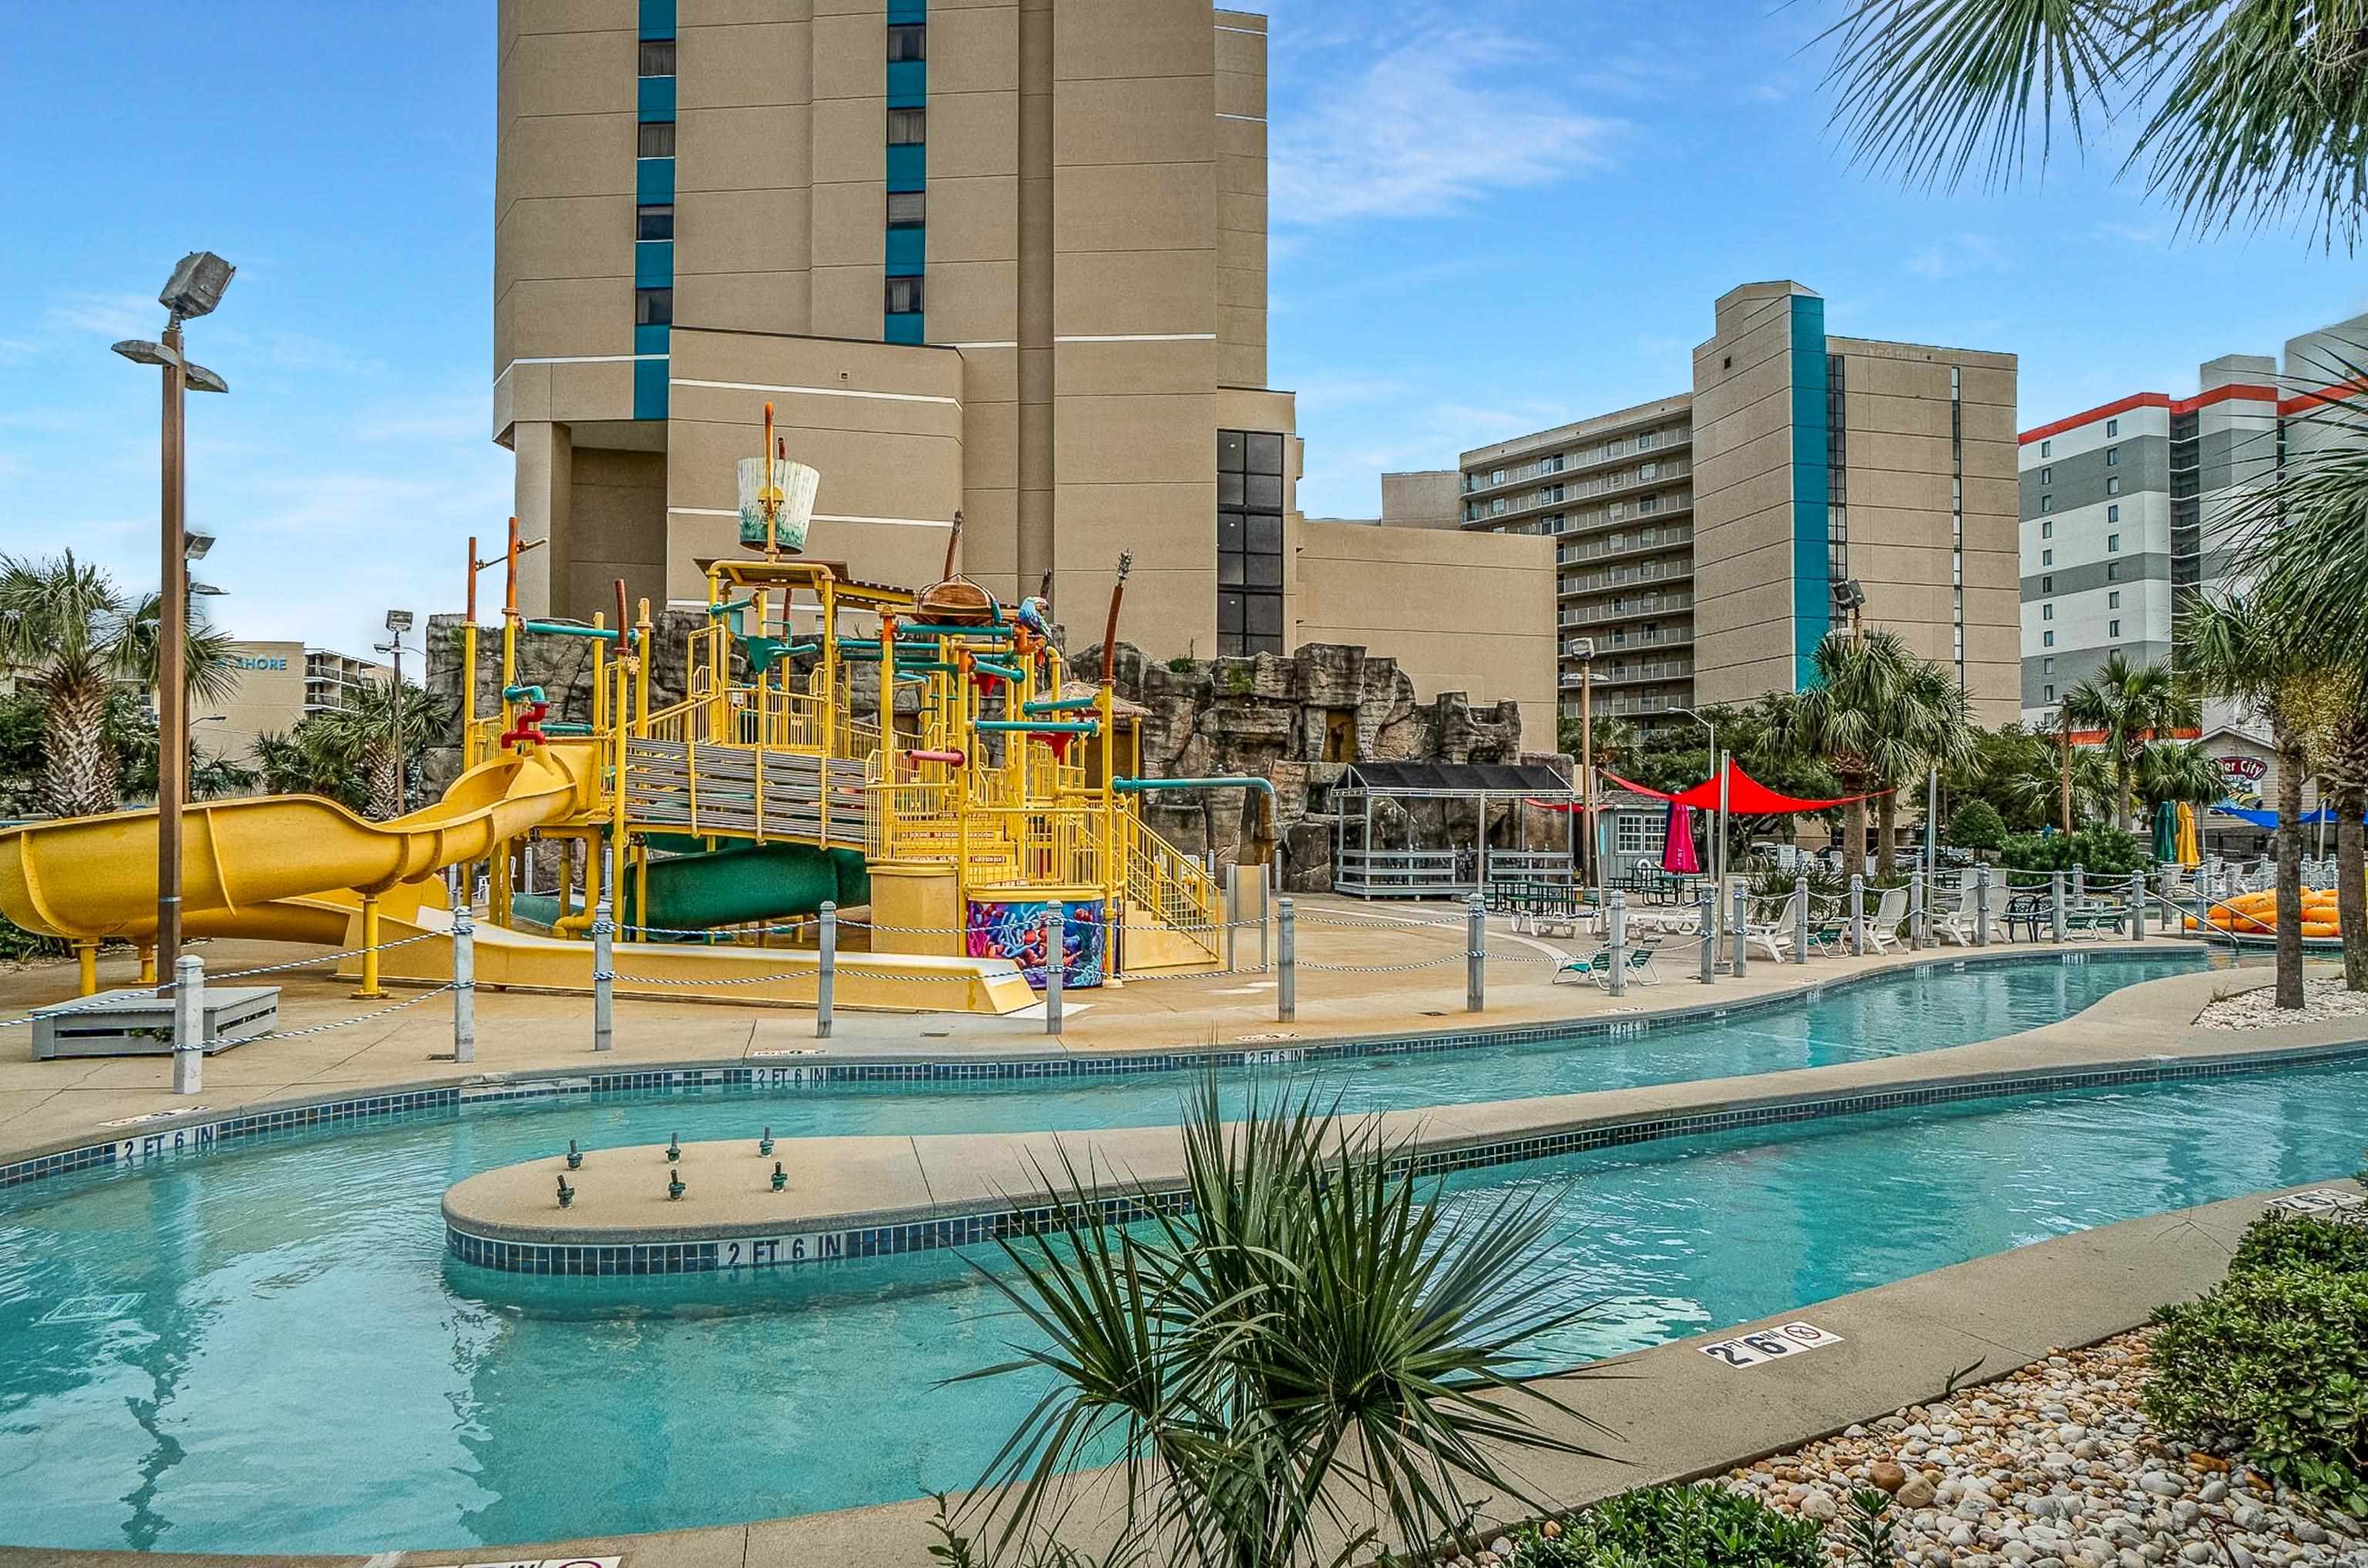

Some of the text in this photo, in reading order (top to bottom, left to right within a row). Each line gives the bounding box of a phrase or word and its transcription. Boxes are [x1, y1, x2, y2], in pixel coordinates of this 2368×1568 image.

[2240, 760, 2263, 778] City
[1249, 1048, 1302, 1064] 2 FT 6 IN
[758, 1066, 824, 1082] 2 FT 6 IN
[124, 1126, 214, 1158] 2 FT 6 IN
[727, 1233, 841, 1265] 2 FT 6 IN
[1706, 1347, 1754, 1365] 2
[1743, 1336, 1788, 1354] 6
